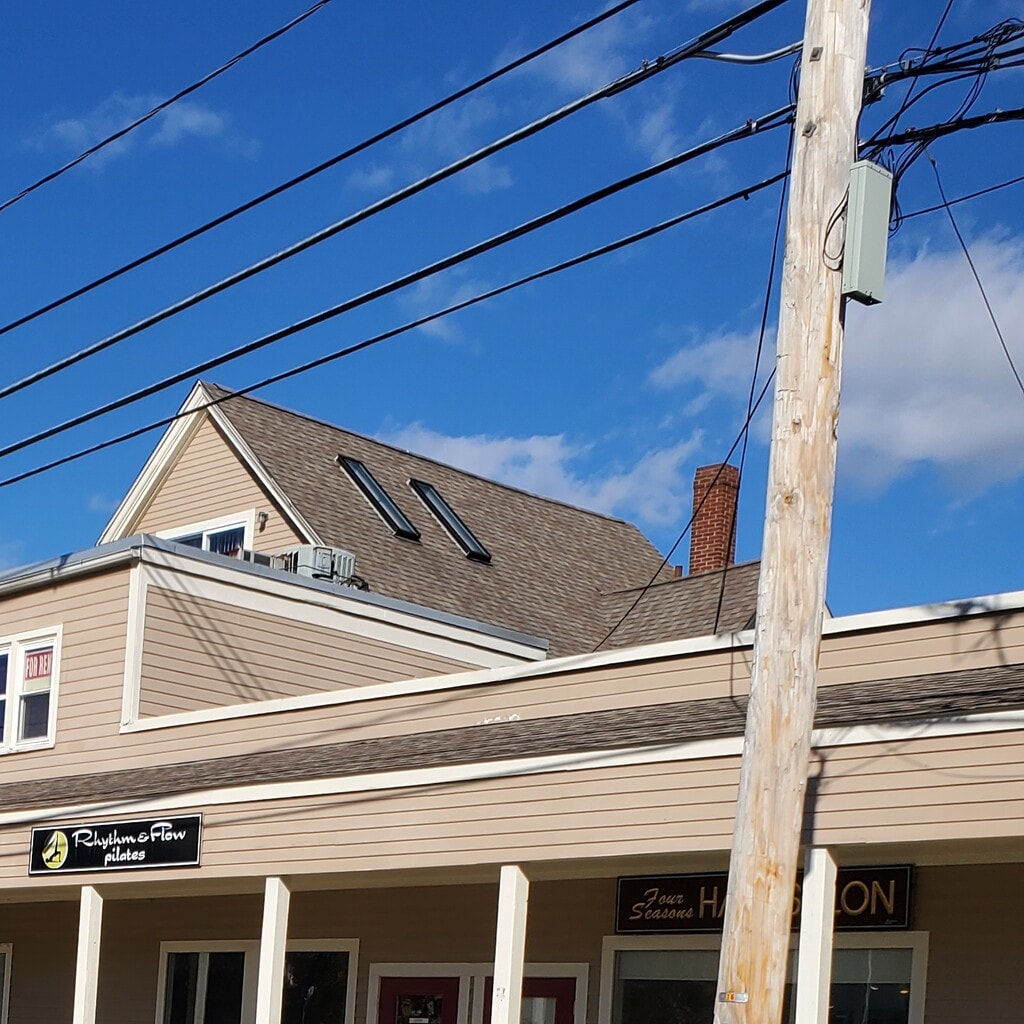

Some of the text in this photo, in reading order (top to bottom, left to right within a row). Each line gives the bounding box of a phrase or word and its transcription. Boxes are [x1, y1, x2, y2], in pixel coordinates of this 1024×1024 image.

[26, 656, 38, 678] FOR
[72, 822, 186, 849] Rhythm & Flow
[104, 848, 146, 867] pilates
[644, 888, 684, 909] Four
[629, 902, 694, 920] Seasons
